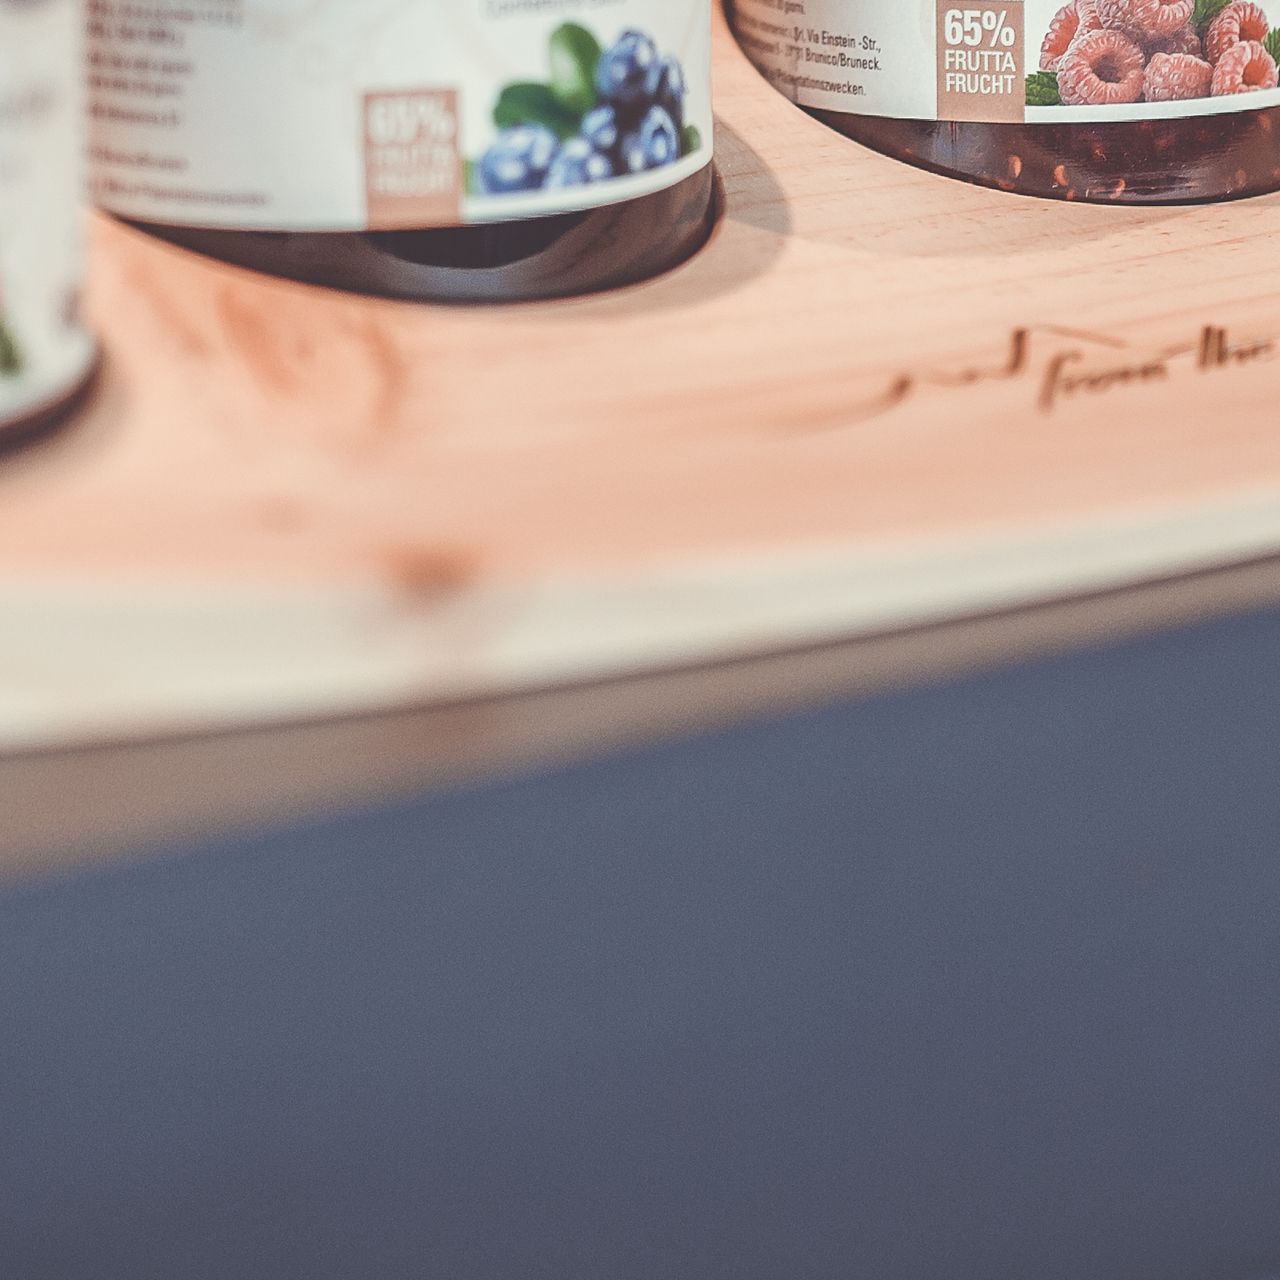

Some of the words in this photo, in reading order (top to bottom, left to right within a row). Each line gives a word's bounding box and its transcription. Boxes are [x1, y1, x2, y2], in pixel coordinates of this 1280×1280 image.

[821, 30, 856, 49] Einstein
[944, 8, 1016, 48] 65%
[805, 47, 882, 72] Brunico/Bruneck.
[944, 48, 1017, 72] FRUTTA
[944, 71, 1017, 95] FRUCHT
